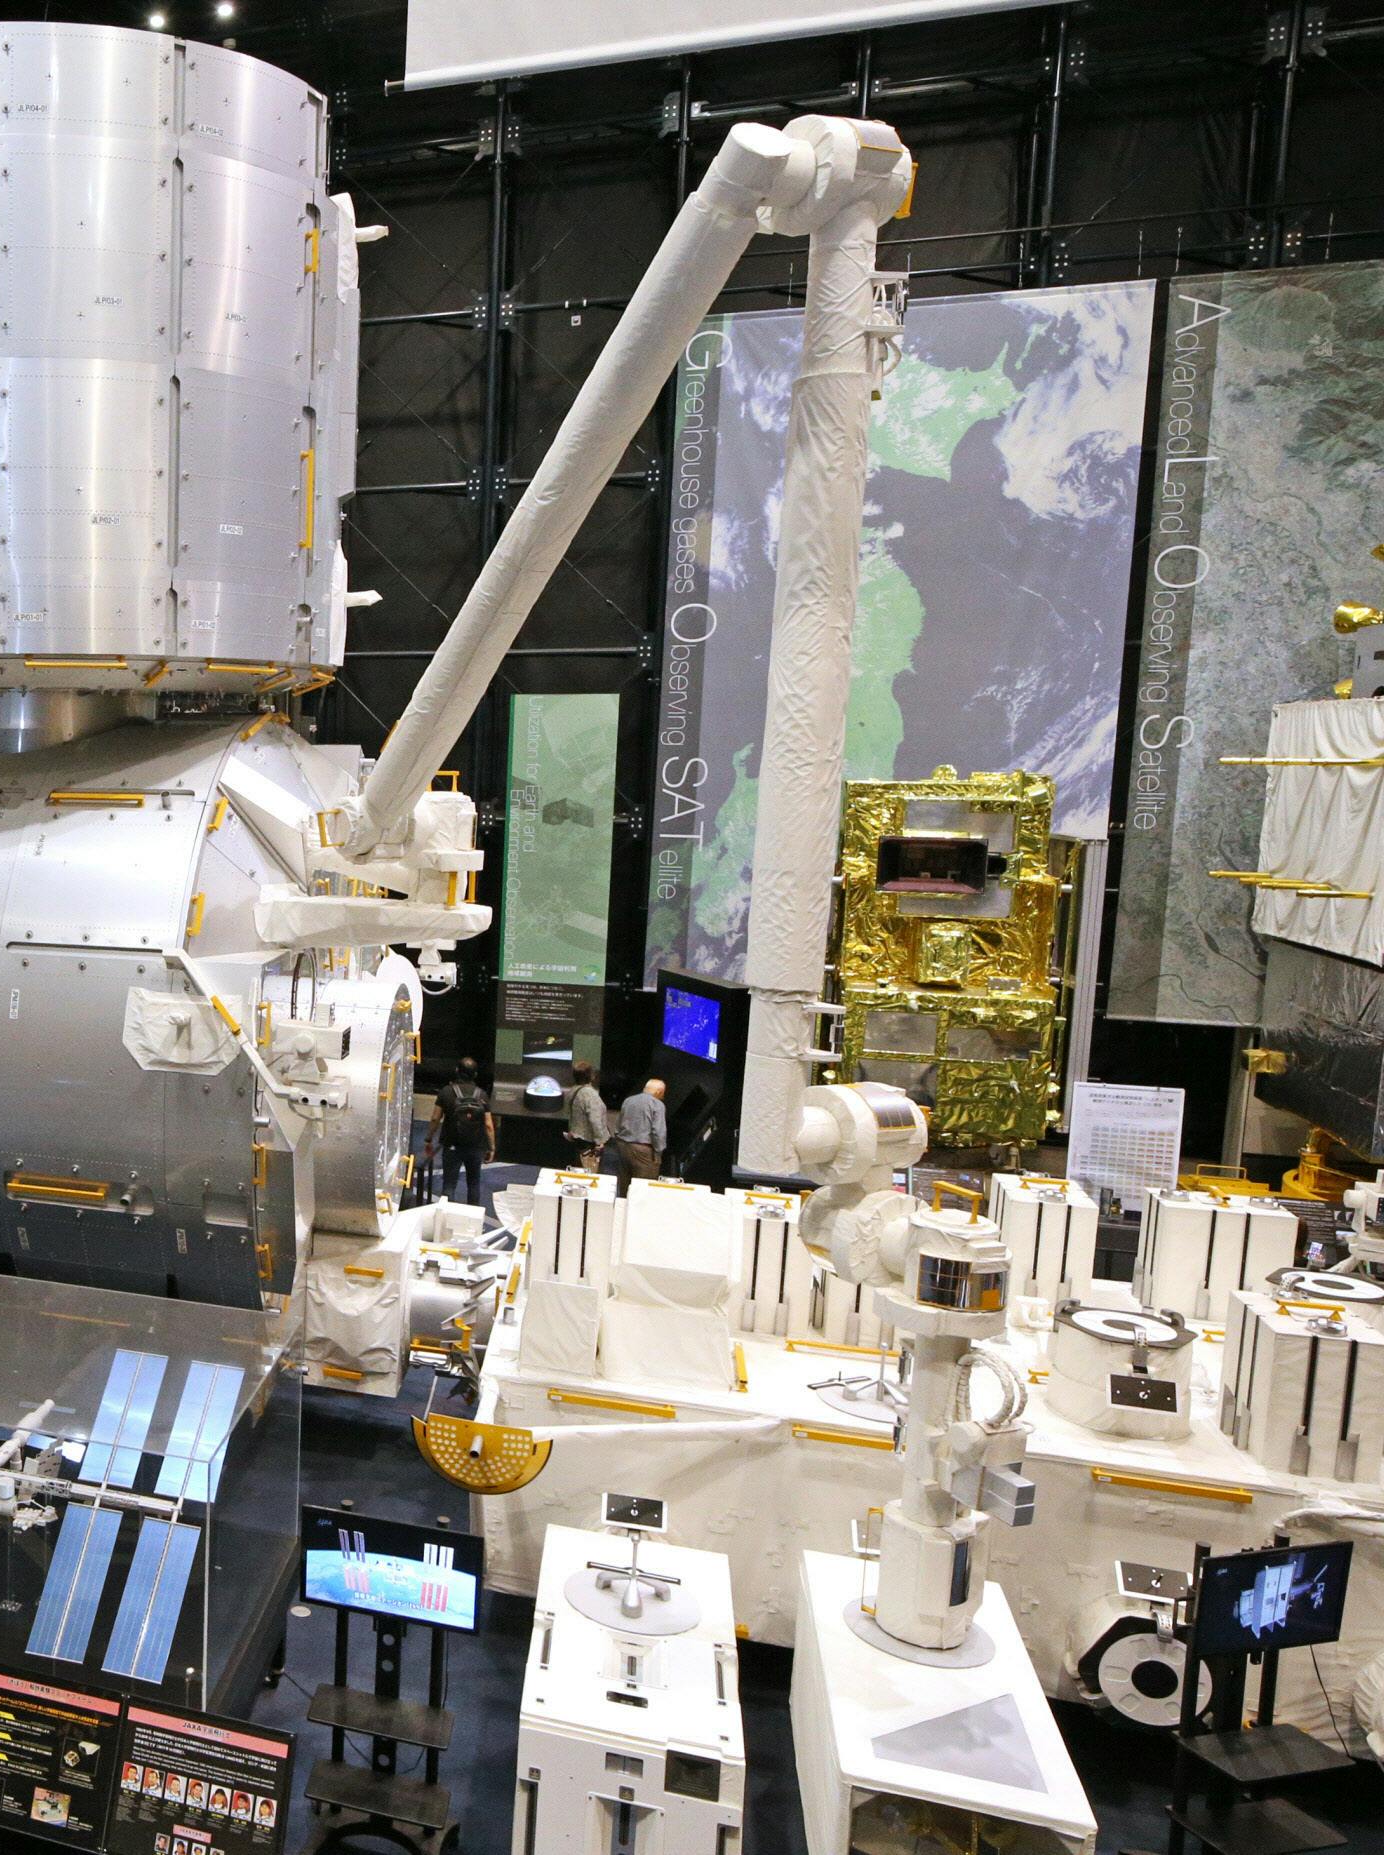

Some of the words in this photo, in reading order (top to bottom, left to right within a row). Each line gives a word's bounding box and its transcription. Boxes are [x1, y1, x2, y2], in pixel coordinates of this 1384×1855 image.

[1167, 294, 1231, 454] Advanced
[679, 330, 733, 509] Greenhouse
[1160, 456, 1219, 533] Land
[672, 517, 698, 594] gases
[1138, 545, 1210, 703] Observing
[660, 603, 717, 746] Observing
[525, 785, 539, 823] Earth
[527, 763, 540, 780] for
[1133, 714, 1195, 830] Satellite
[507, 789, 525, 873] Environment
[522, 825, 537, 853] and
[504, 877, 521, 960] Observation
